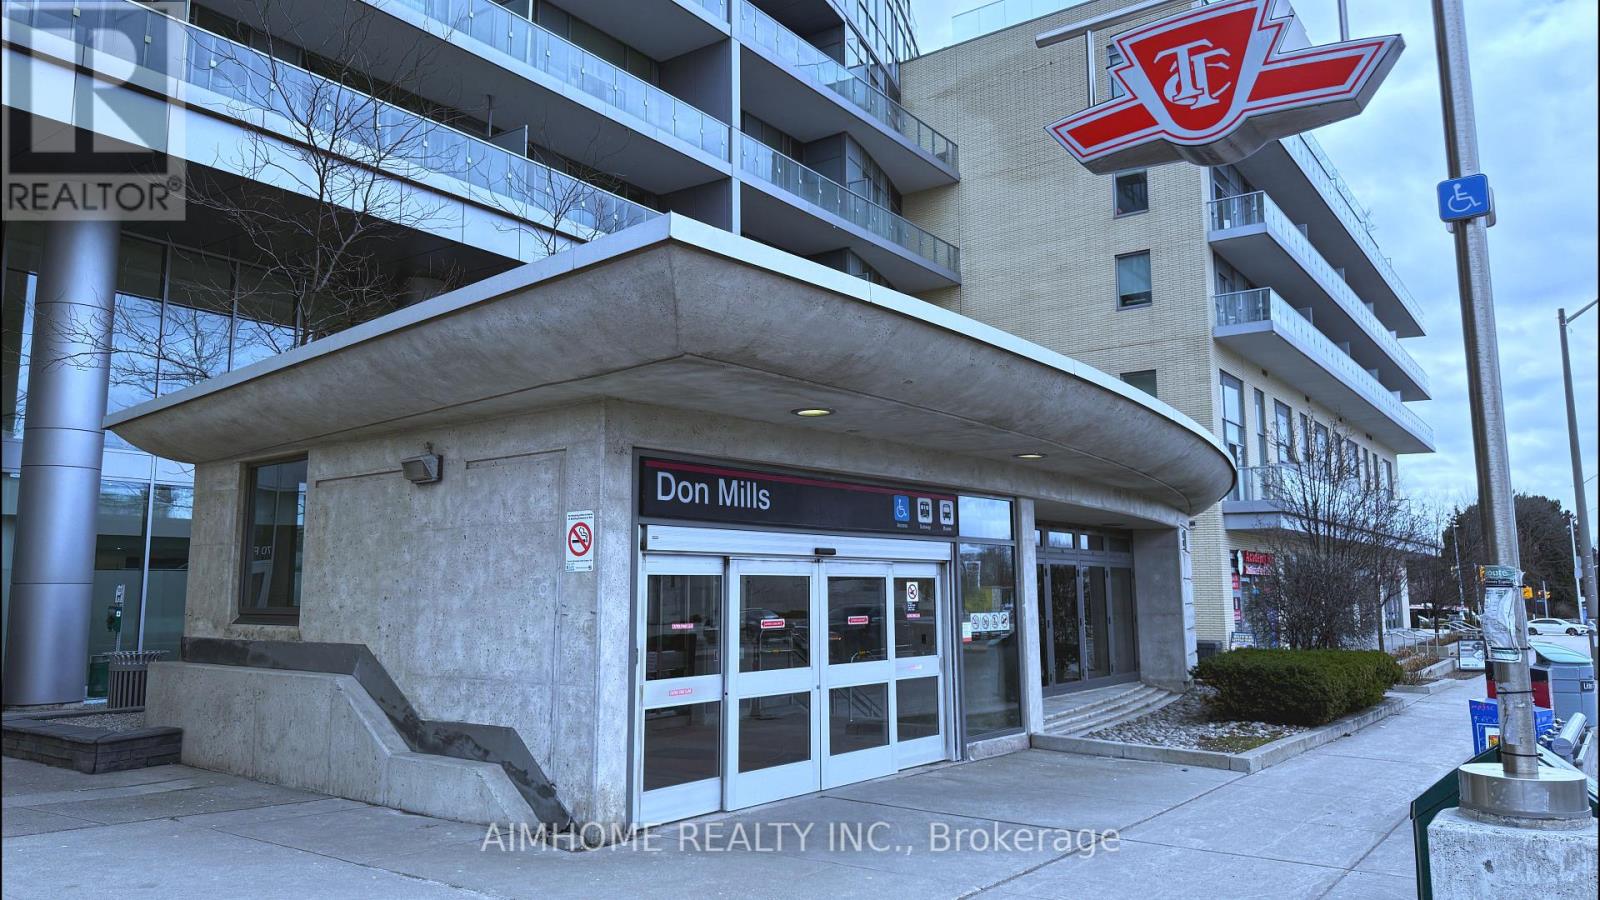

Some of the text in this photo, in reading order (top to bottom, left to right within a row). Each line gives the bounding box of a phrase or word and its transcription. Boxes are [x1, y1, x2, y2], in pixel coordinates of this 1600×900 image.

[1153, 38, 1231, 110] TTC
[656, 471, 771, 510] Don Mills
